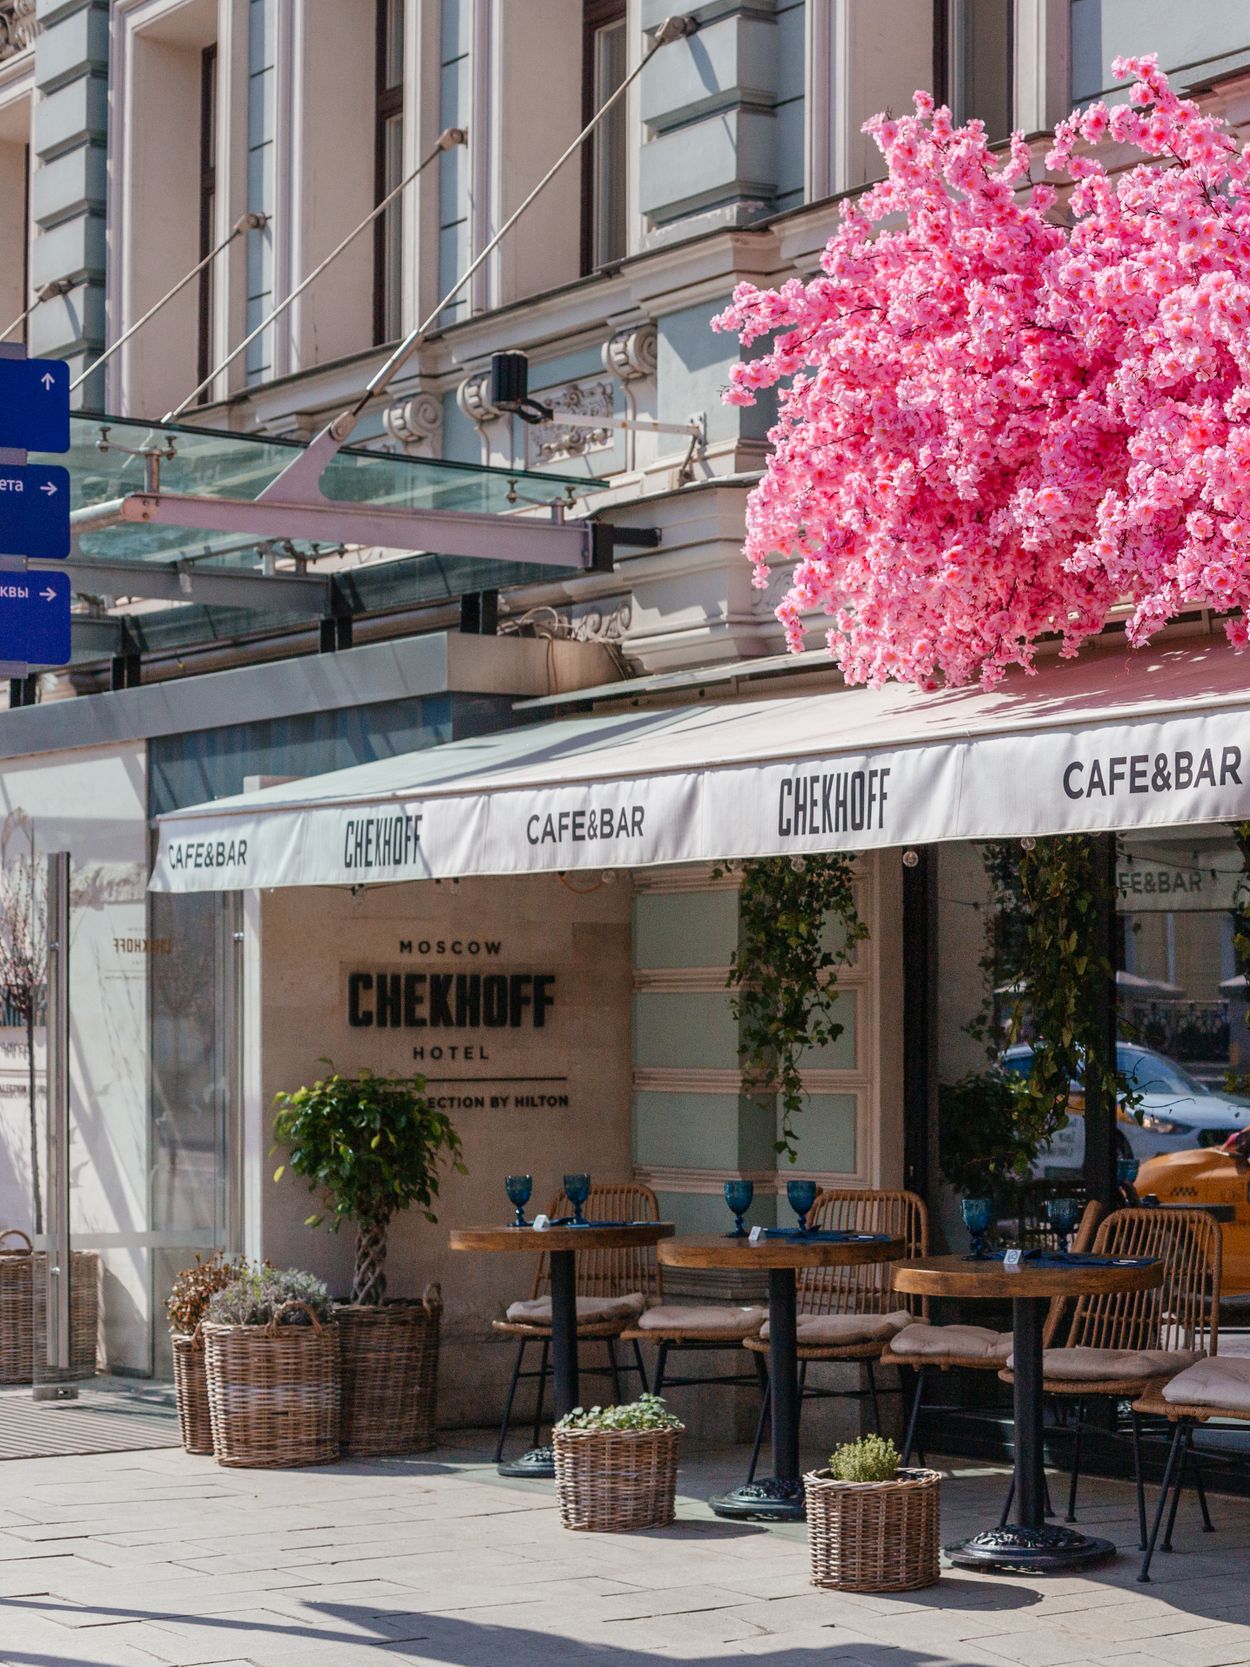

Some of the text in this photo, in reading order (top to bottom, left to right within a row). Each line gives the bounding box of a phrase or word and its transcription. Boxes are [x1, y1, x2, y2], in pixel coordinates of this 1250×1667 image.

[168, 745, 1243, 870] CAFE&BAR CHEKHOFF CAFE&BAR CHEKHOFF CAFE&BAR
[1118, 871, 1203, 894] FE&BAR
[400, 940, 503, 955] MOSCOW
[348, 972, 556, 1028] CHEKHOFF
[412, 1046, 489, 1061] HOTEL
[427, 1095, 569, 1109] ECTION BY HILTON
